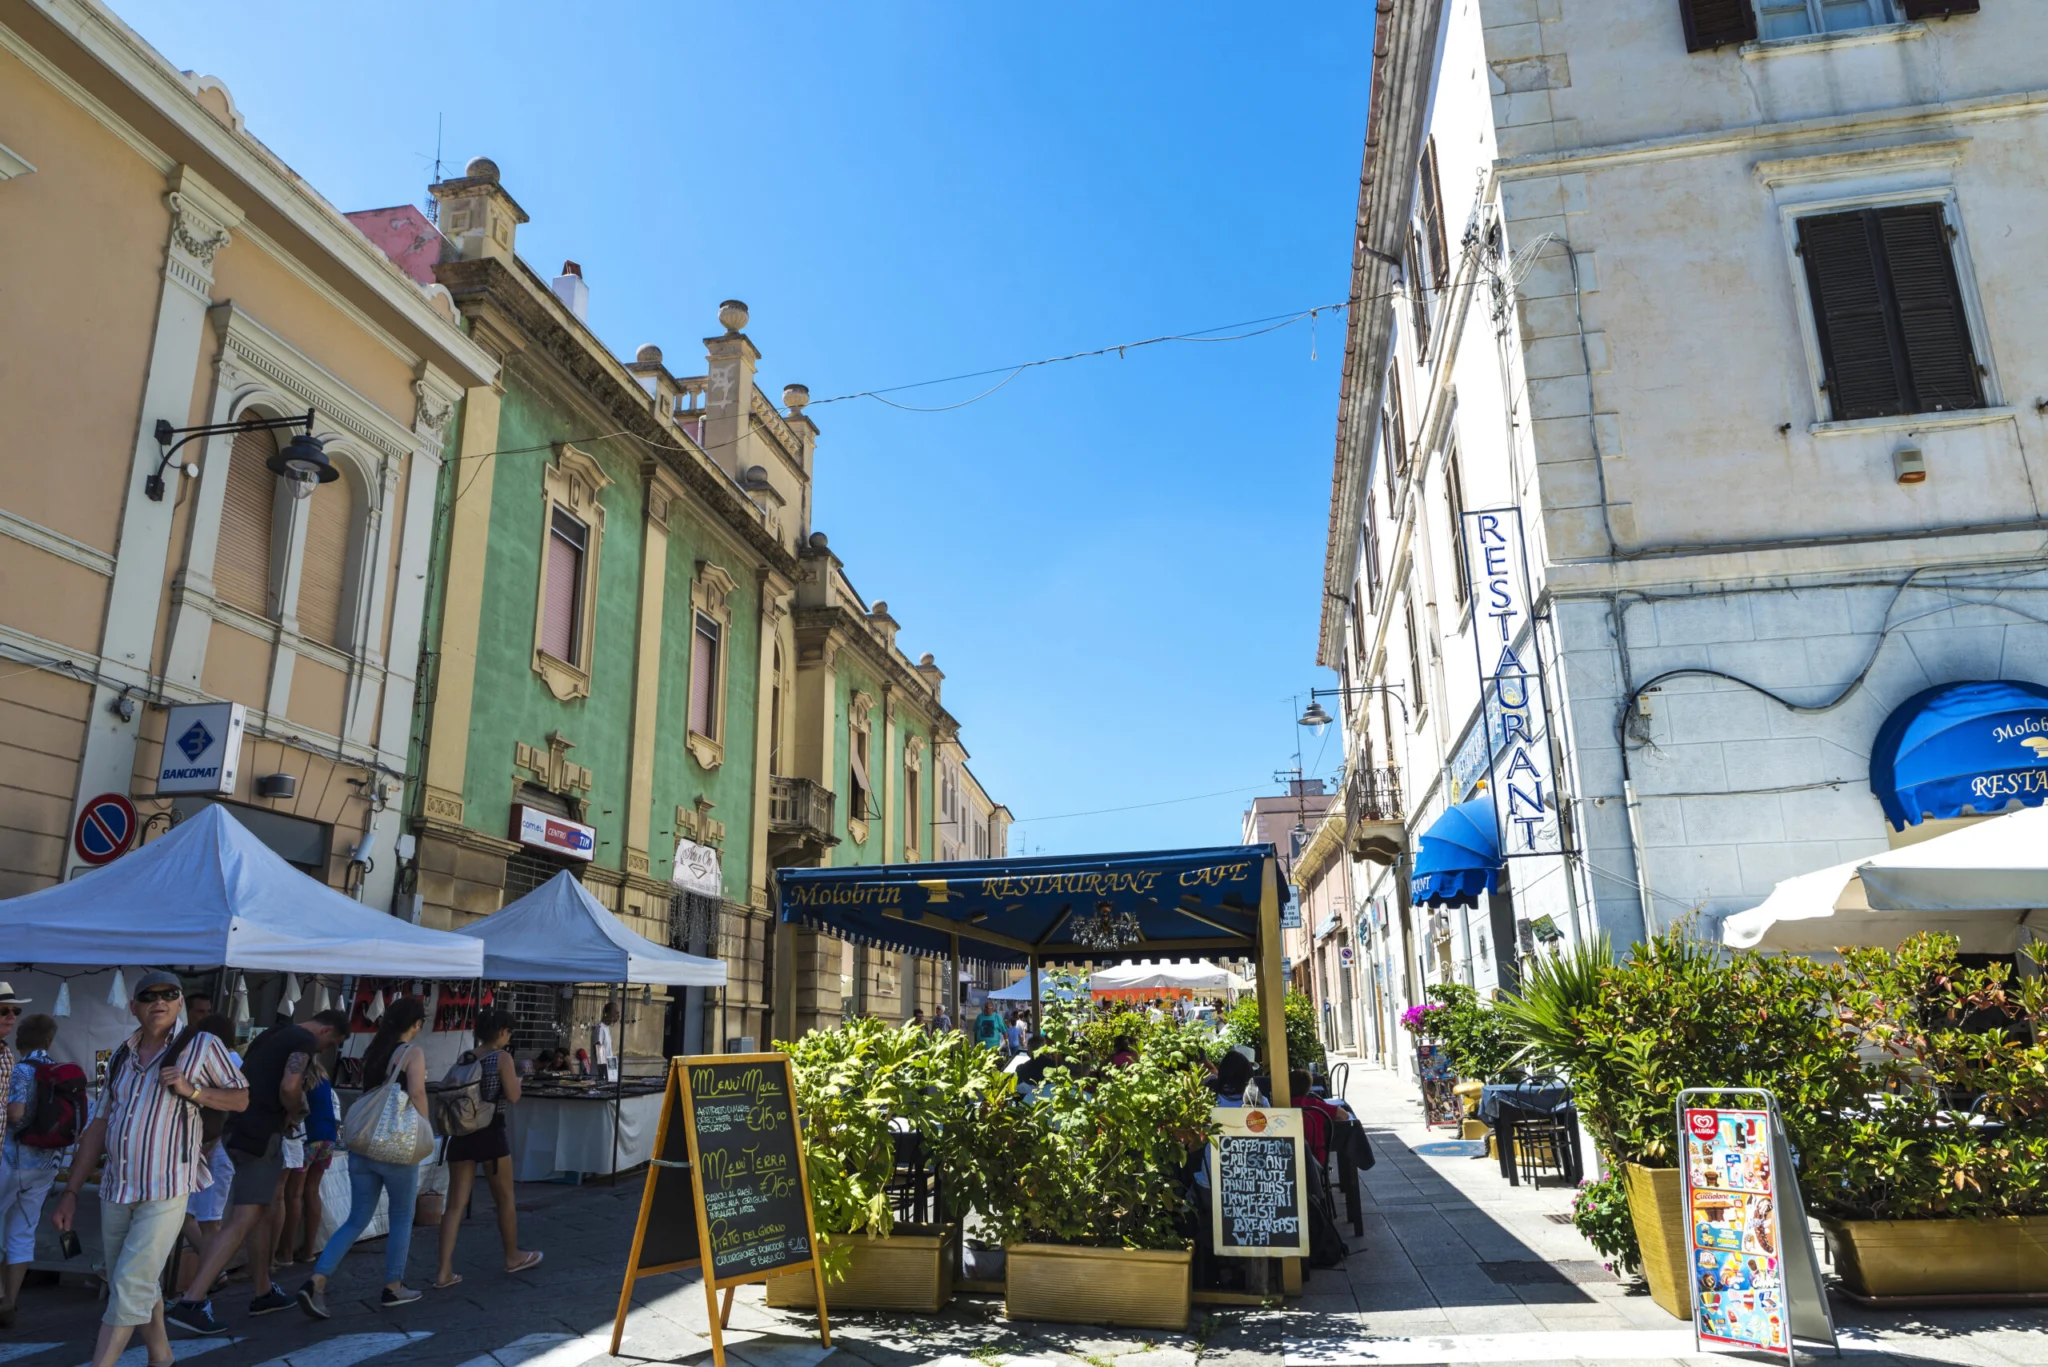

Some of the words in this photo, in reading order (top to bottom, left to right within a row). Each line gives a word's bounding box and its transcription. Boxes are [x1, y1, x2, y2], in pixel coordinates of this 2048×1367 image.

[1478, 515, 1545, 850] RESTAURANT
[162, 767, 219, 779] BANCOMAT
[547, 828, 567, 840] CENTRO
[579, 836, 591, 848] TIM
[790, 882, 902, 907] Molobrin
[982, 872, 1162, 900] RESTAURANT
[1222, 1167, 1286, 1182] SPREMUTE
[1223, 1206, 1276, 1219] ENGLISH
[1232, 1217, 1298, 1234] BREAKFAST
[743, 1230, 759, 1241] DEL
